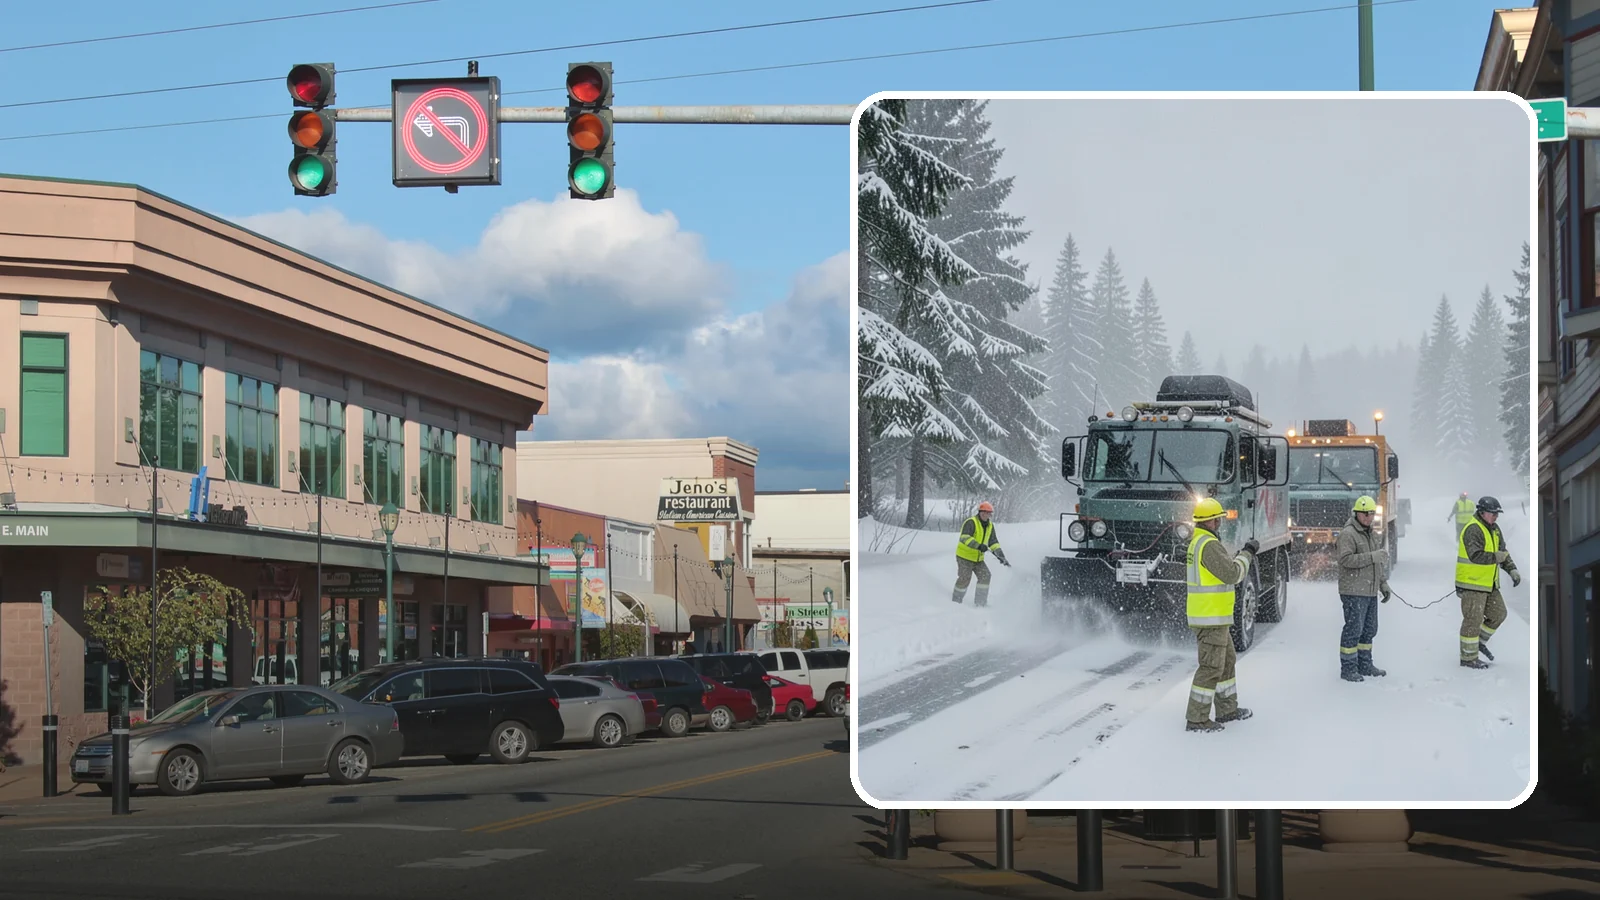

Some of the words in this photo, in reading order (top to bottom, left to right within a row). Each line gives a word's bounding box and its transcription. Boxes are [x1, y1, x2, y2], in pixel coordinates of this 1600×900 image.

[669, 480, 727, 494] Jeno's
[665, 496, 731, 509] restaurant
[659, 509, 682, 519] Italian
[686, 509, 715, 519] American
[715, 509, 737, 519] Cuisine
[2, 525, 13, 536] E.
[15, 525, 49, 536] MAIN
[786, 608, 795, 616] in
[797, 608, 828, 616] Street
